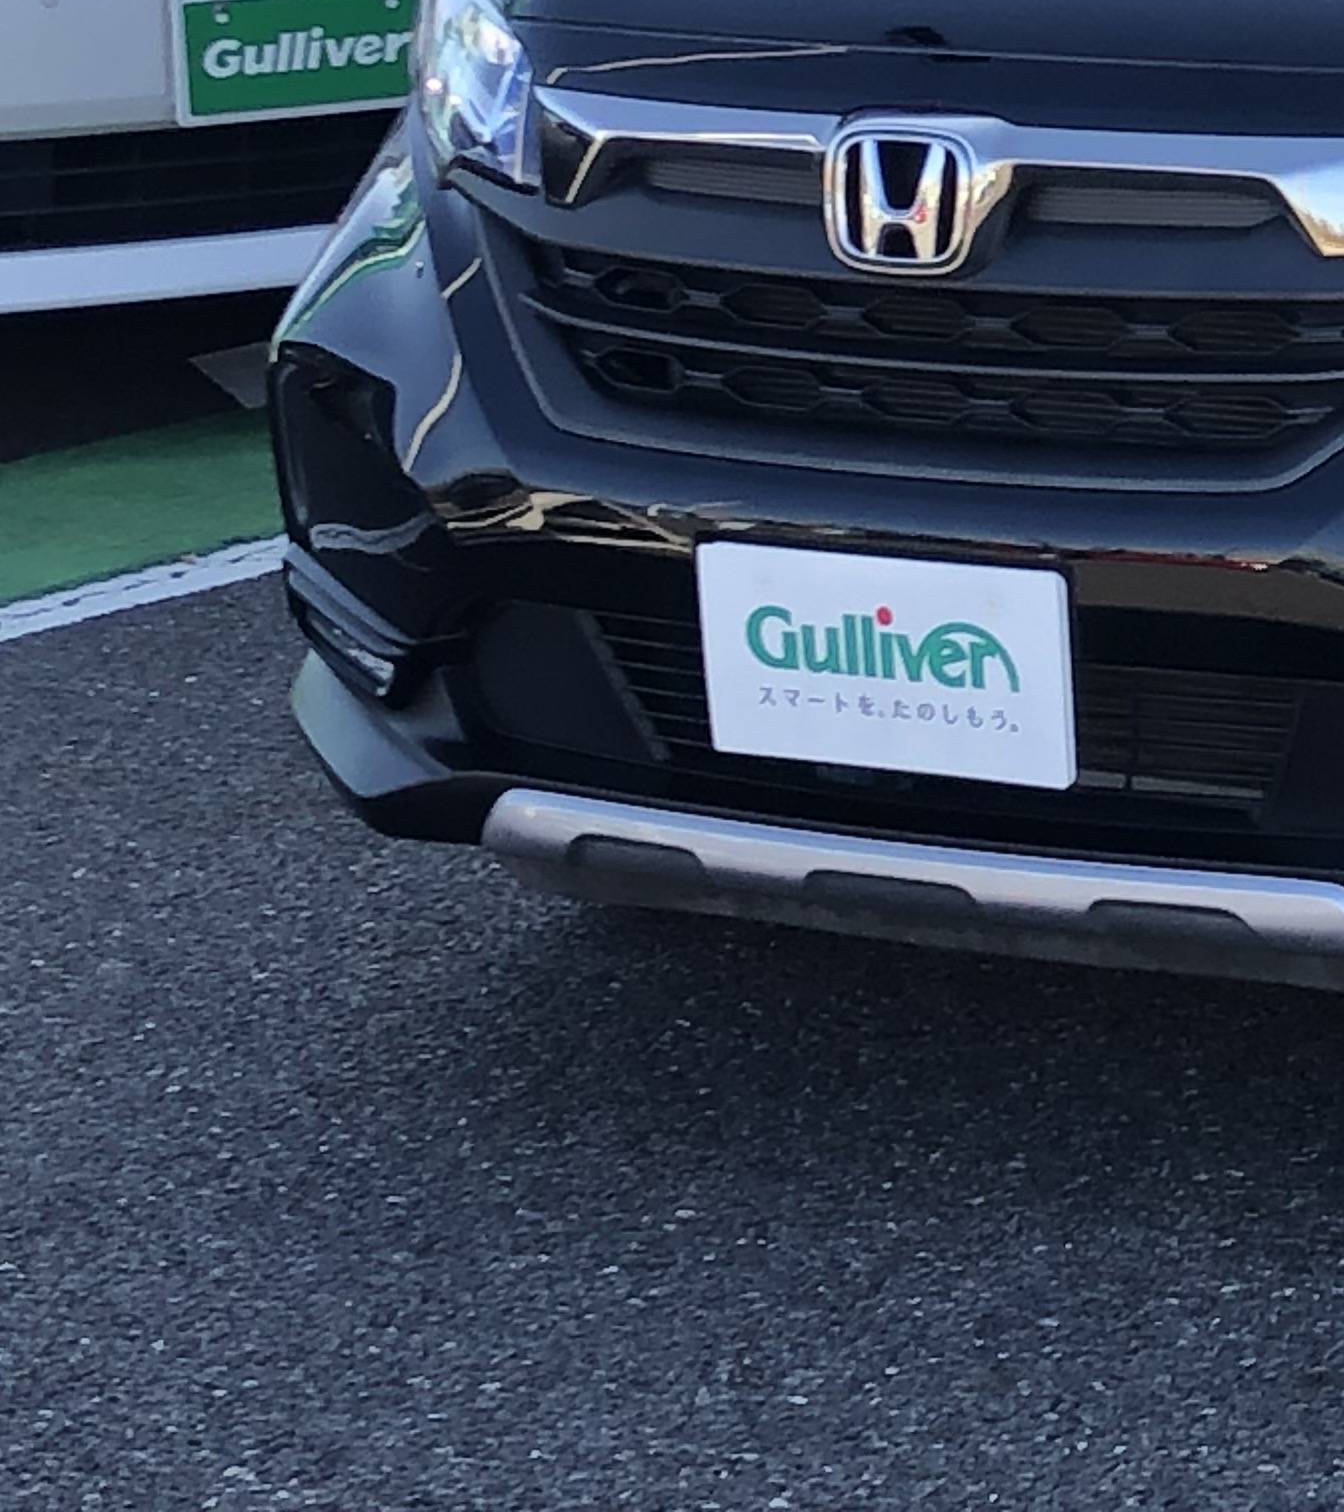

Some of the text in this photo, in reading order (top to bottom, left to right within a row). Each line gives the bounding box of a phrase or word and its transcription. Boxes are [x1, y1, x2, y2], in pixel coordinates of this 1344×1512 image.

[202, 25, 412, 79] Gulliver
[745, 604, 1020, 693] Gulliver
[758, 686, 1020, 734] スマートを、たのしもう。
